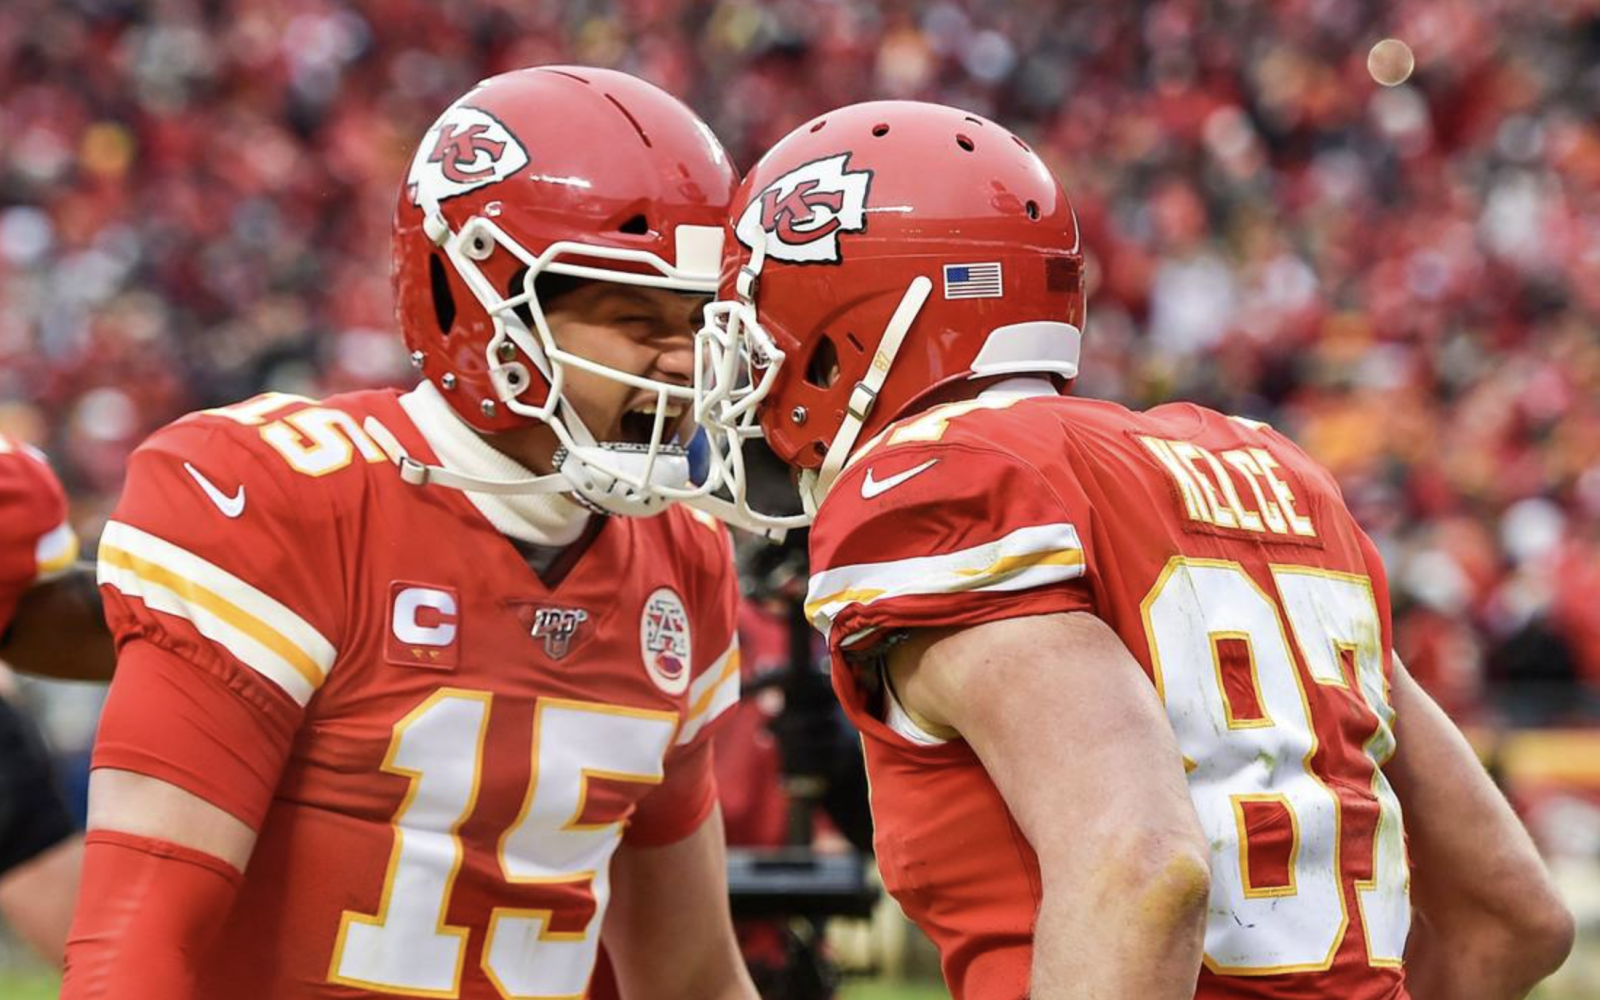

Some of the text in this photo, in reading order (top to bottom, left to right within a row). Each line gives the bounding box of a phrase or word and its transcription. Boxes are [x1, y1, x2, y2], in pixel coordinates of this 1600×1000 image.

[428, 123, 507, 184] KC
[759, 178, 845, 245] KC
[201, 391, 388, 478] 15
[1138, 435, 1317, 537] KELCE
[392, 587, 458, 647] C
[1139, 555, 1411, 977] 87
[327, 687, 680, 1000] 15
